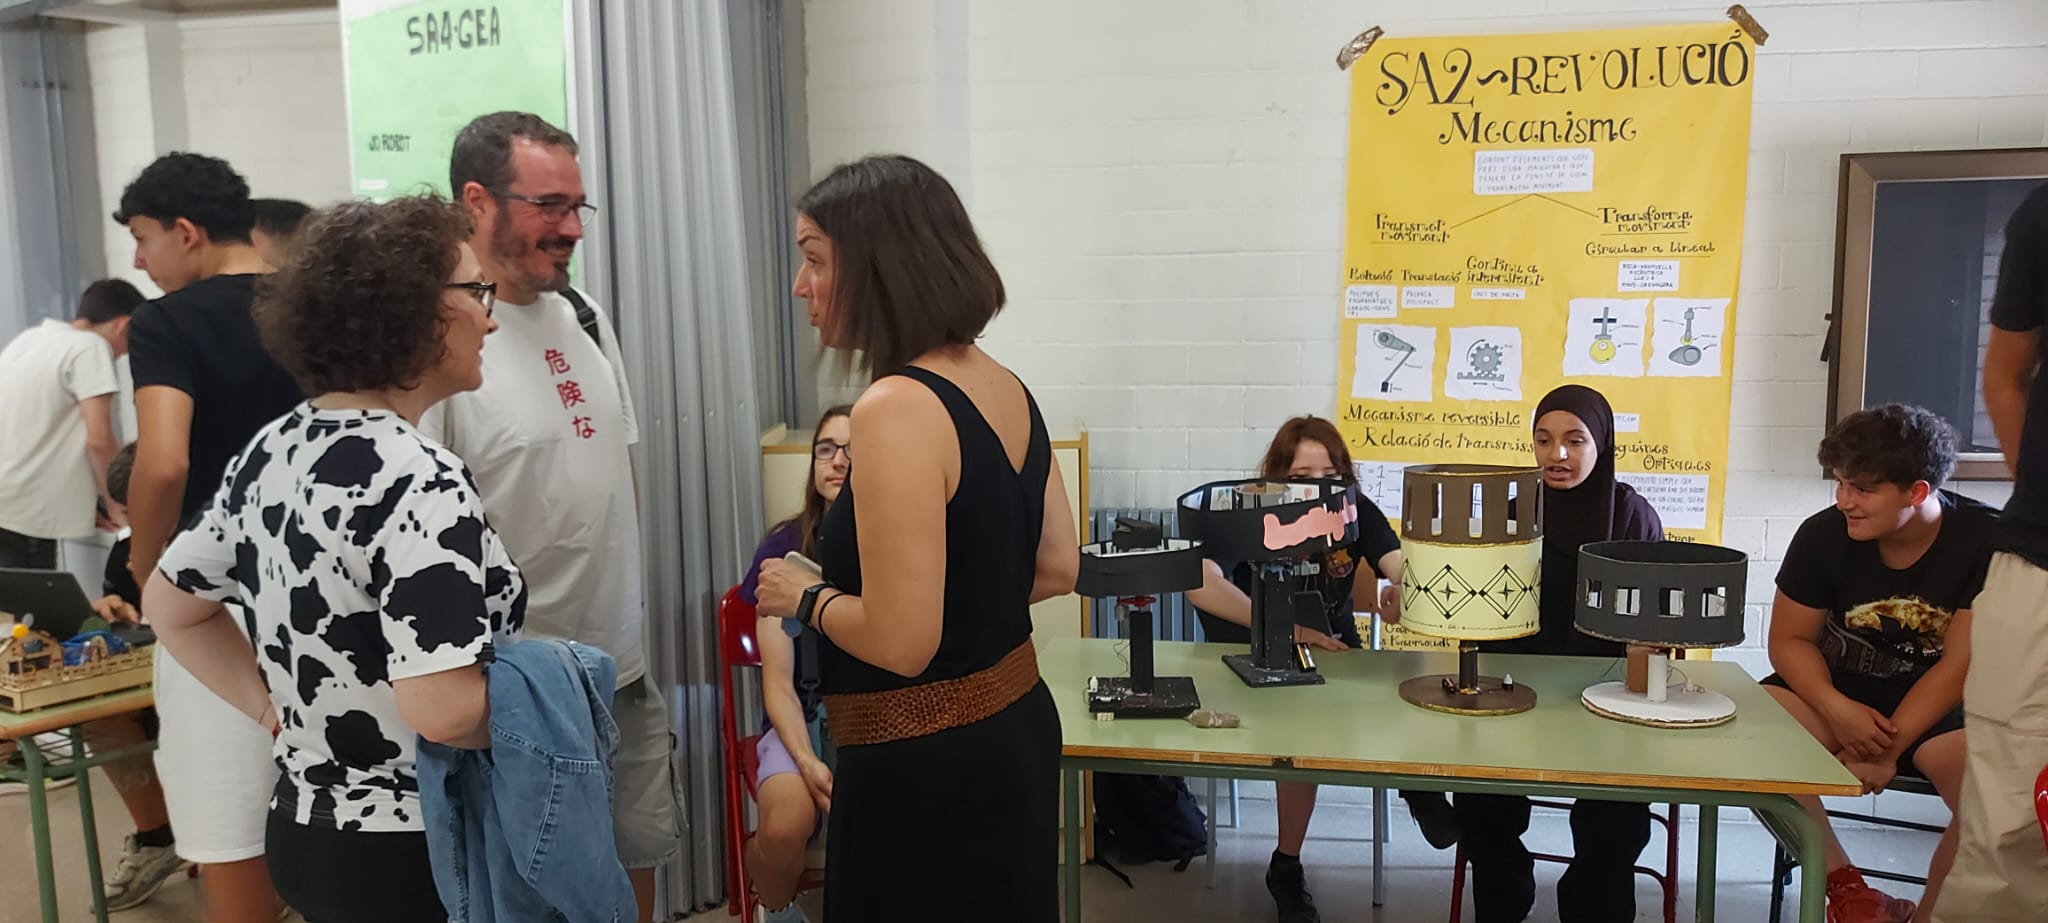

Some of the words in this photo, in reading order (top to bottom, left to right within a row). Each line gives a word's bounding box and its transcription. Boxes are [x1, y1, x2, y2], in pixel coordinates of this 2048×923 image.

[1438, 111, 1637, 144] Mecanisme
[1597, 206, 1693, 225] Transforma
[1585, 241, 1648, 256] Circular
[545, 349, 595, 439] 危険な
[1344, 404, 1435, 422] Mecanisme
[1442, 410, 1520, 426] reversible
[1433, 432, 1453, 449] de
